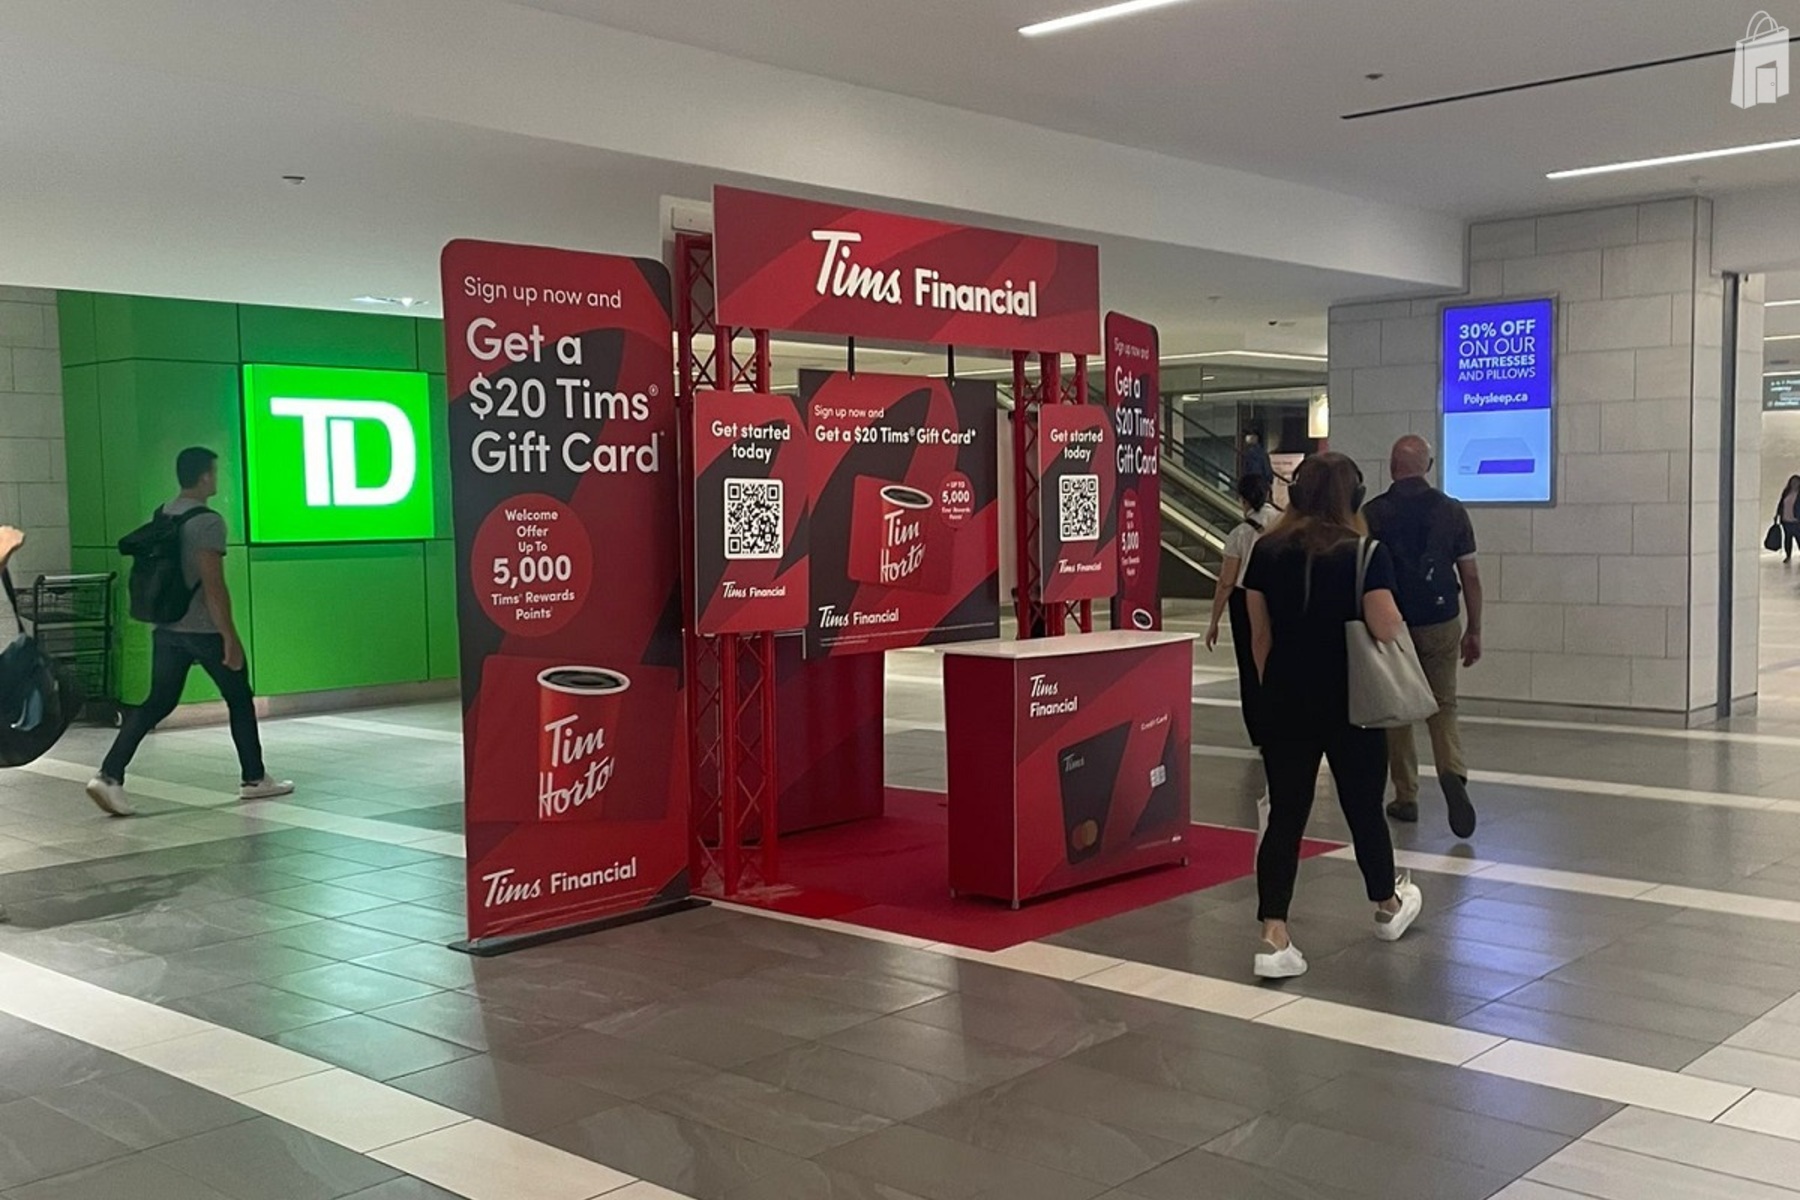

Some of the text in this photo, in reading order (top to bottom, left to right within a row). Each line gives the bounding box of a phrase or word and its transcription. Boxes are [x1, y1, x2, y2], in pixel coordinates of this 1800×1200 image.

[810, 230, 1038, 318] Tims Financial
[464, 276, 622, 309] Sign up now and
[1459, 319, 1536, 340] 30% OFF
[466, 317, 583, 365] Get a
[1459, 336, 1536, 358] ON OUR
[1459, 354, 1536, 370] MATTRESSES
[1115, 365, 1141, 399] Get a
[1458, 366, 1536, 382] AND PILLOWS
[469, 372, 547, 421] $20
[1463, 392, 1528, 406] Polysleep.ca
[814, 404, 885, 420] Sign up now and
[1115, 403, 1157, 439] $20 Tims
[711, 420, 791, 441] Get started
[815, 425, 840, 442] Get
[842, 429, 851, 442] a
[854, 426, 878, 443] $20
[916, 428, 939, 444] Gift
[1050, 428, 1104, 443] Get started
[269, 396, 417, 507] TD
[471, 430, 551, 474] Gift
[731, 443, 772, 464] today
[1064, 446, 1091, 462] today
[1116, 444, 1134, 474] Gift
[942, 490, 970, 505] 5,000
[504, 509, 559, 521] Welcome
[516, 525, 549, 538] Offer
[883, 509, 920, 547] Tim
[518, 541, 548, 555] Up To
[493, 554, 572, 589] 5,000
[525, 589, 575, 604] Rewards
[722, 581, 786, 599] Tims Financial
[818, 605, 899, 628] Tims Financial
[1030, 674, 1059, 697] Tims
[1030, 696, 1078, 717] Financial
[544, 714, 606, 768] Tim
[482, 856, 637, 908] Tims Financial
